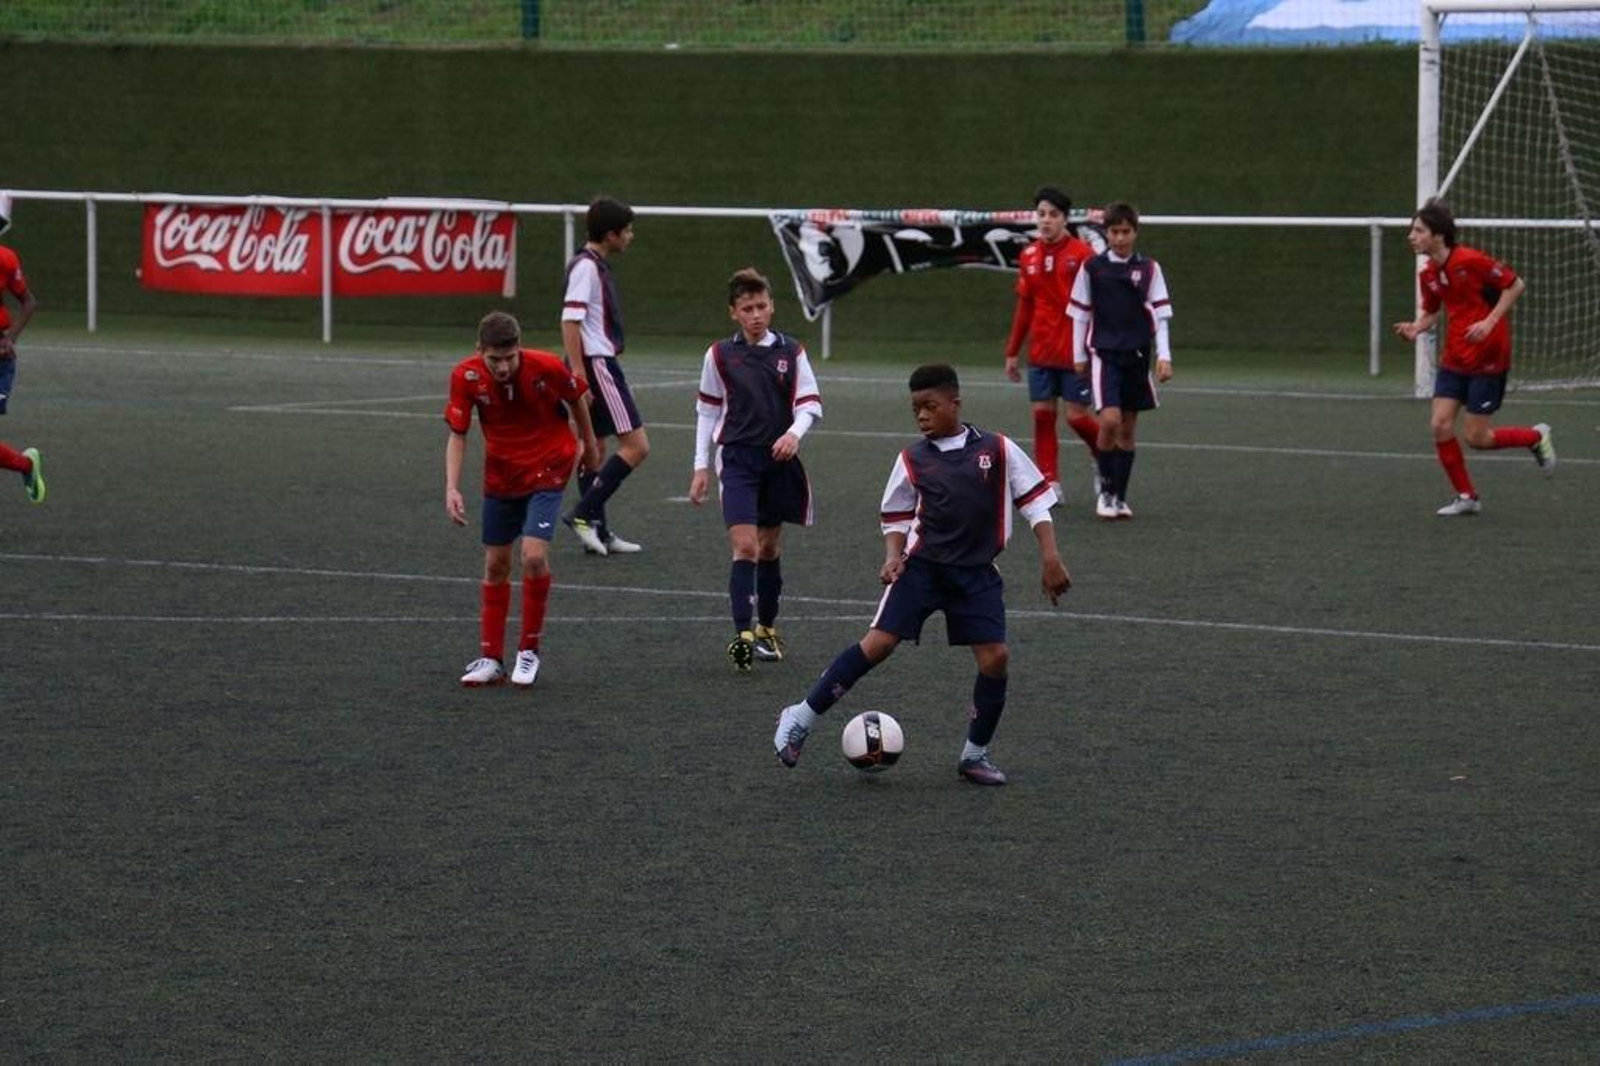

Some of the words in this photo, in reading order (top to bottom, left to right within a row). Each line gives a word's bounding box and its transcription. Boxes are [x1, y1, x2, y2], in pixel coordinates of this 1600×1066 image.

[153, 203, 310, 273] Coca-Cola
[338, 207, 511, 273] Coca-Cola
[1044, 255, 1054, 272] 9
